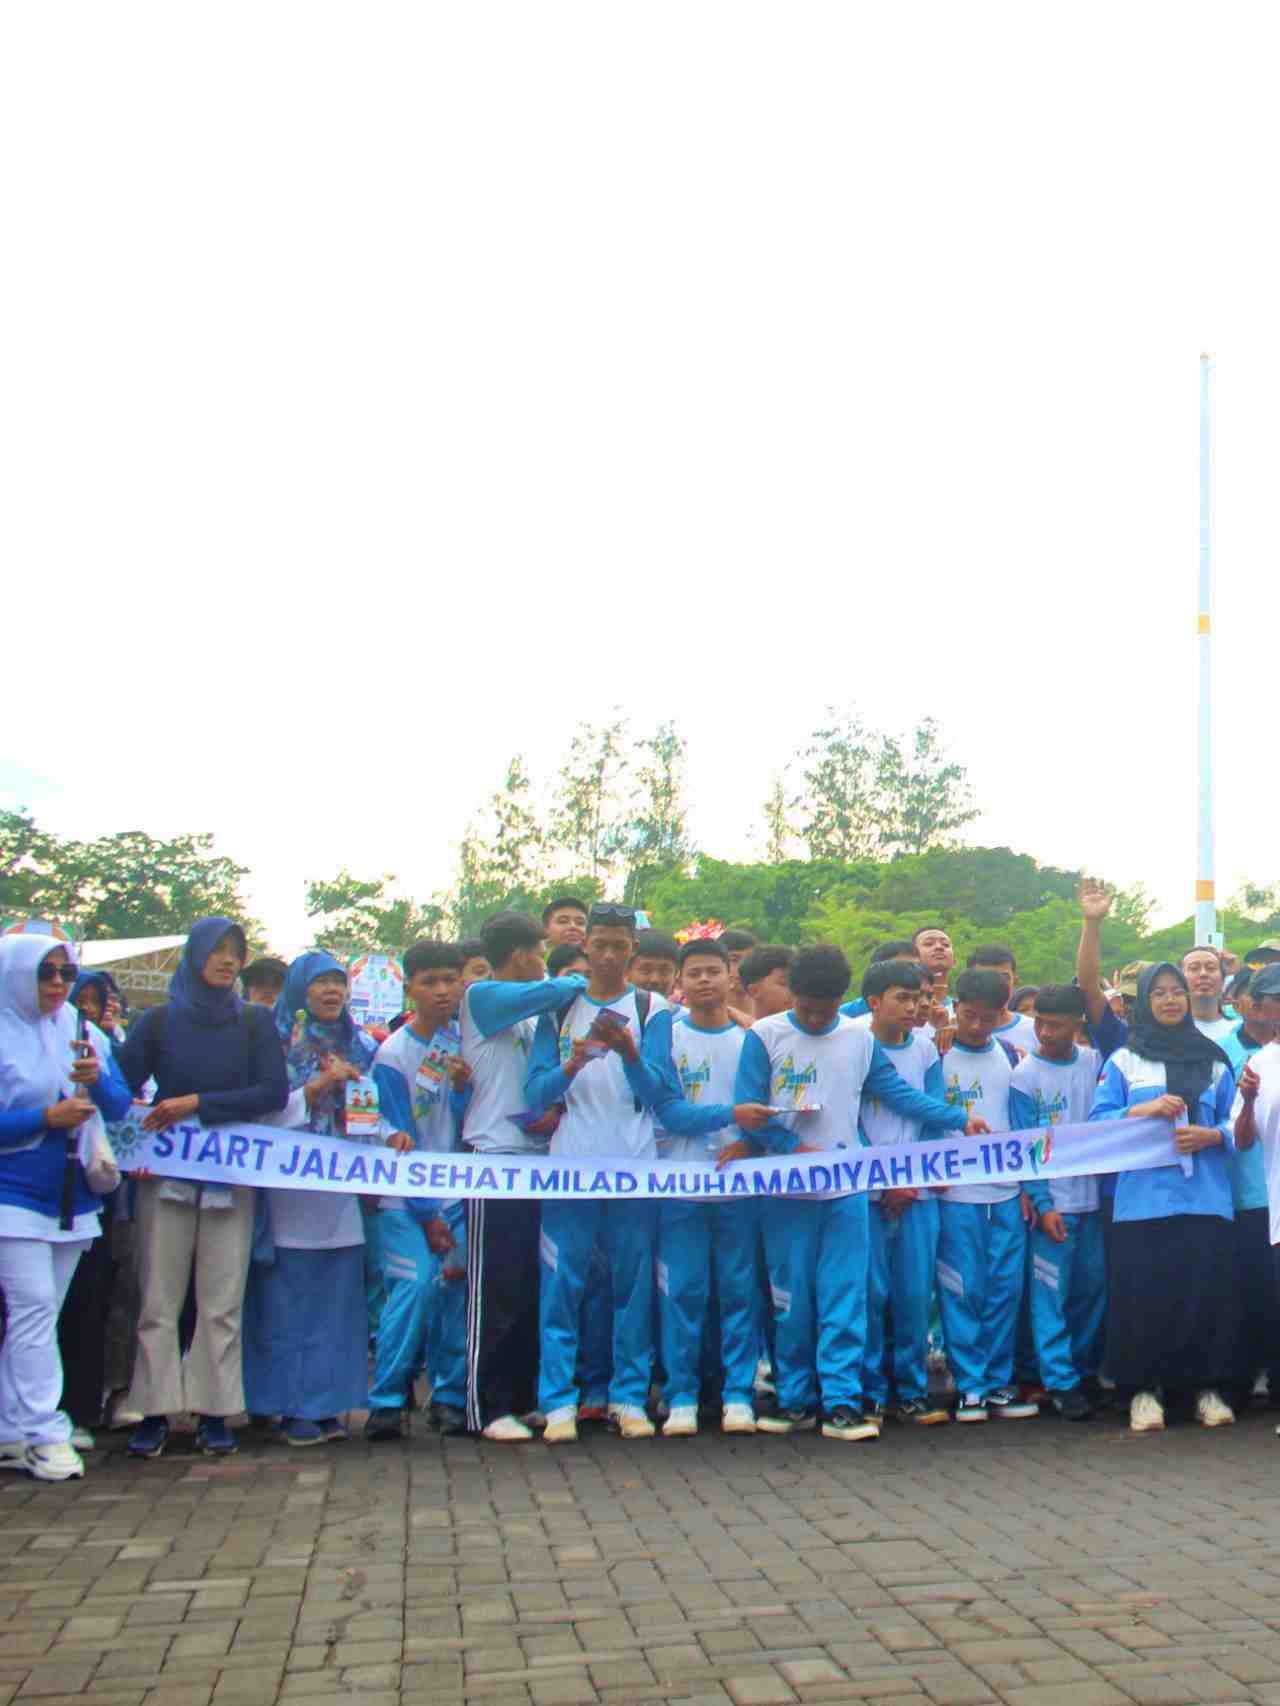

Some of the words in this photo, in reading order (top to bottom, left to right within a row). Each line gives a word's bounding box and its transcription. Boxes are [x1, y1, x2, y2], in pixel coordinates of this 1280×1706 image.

[153, 1122, 273, 1172] START
[279, 1144, 398, 1185] JALAN
[407, 1161, 521, 1191] SEHAT
[530, 1168, 637, 1193] MILAD
[648, 1154, 913, 1194] MUHAMADIYAH
[921, 1139, 1024, 1182] KE-113
